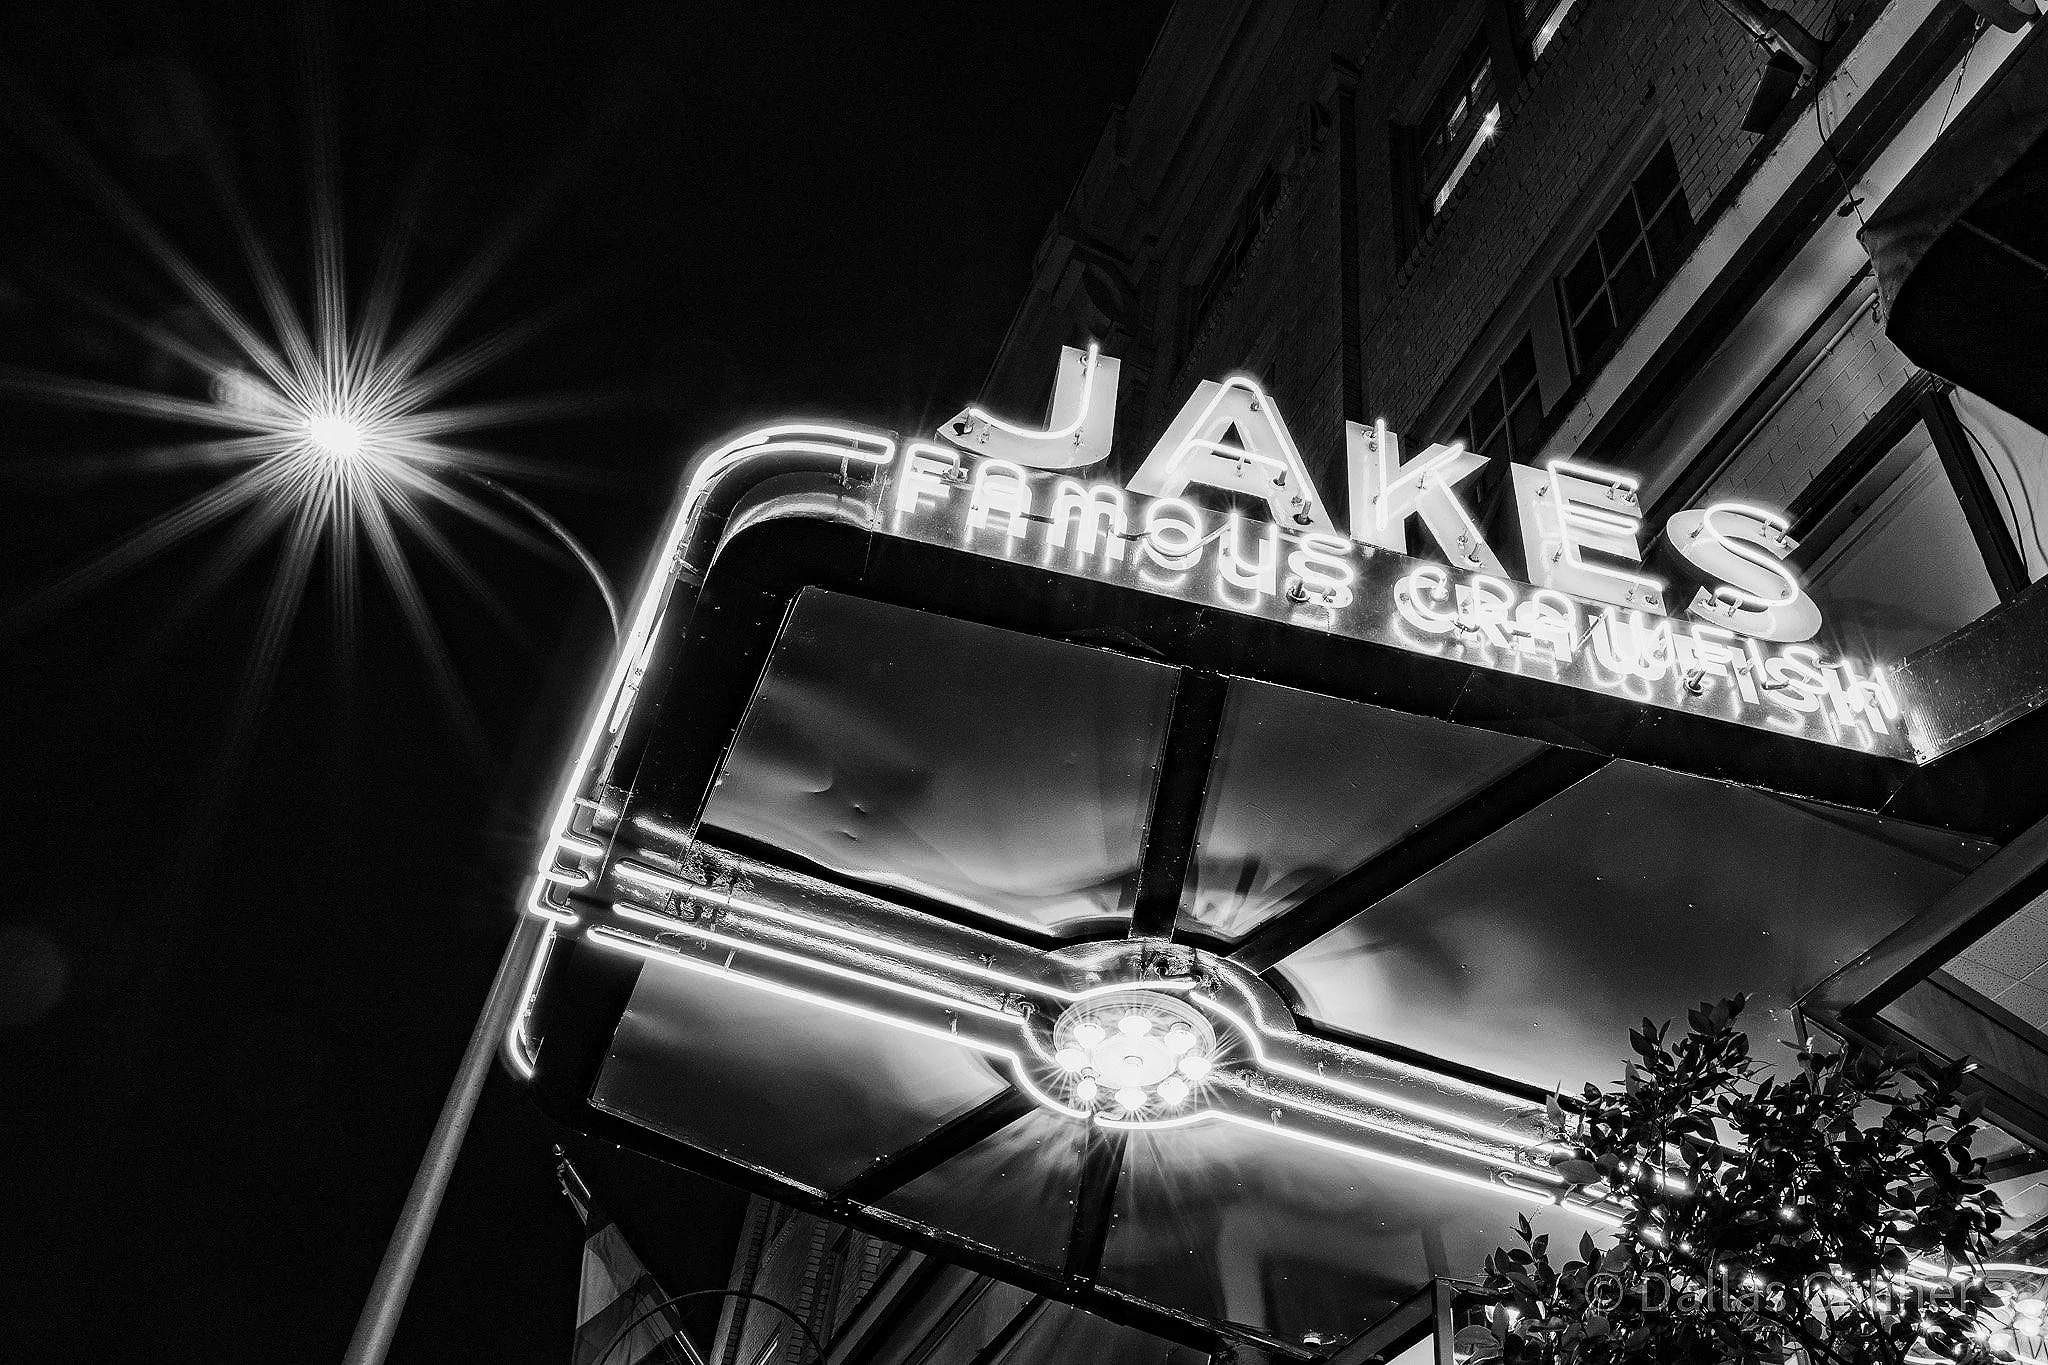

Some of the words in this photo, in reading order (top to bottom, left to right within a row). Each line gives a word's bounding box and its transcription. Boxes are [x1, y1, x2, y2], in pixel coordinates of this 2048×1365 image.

[897, 443, 1356, 609] FAMOUS
[1393, 565, 1899, 736] CRAWFISH
[936, 343, 1823, 642] JAKES
